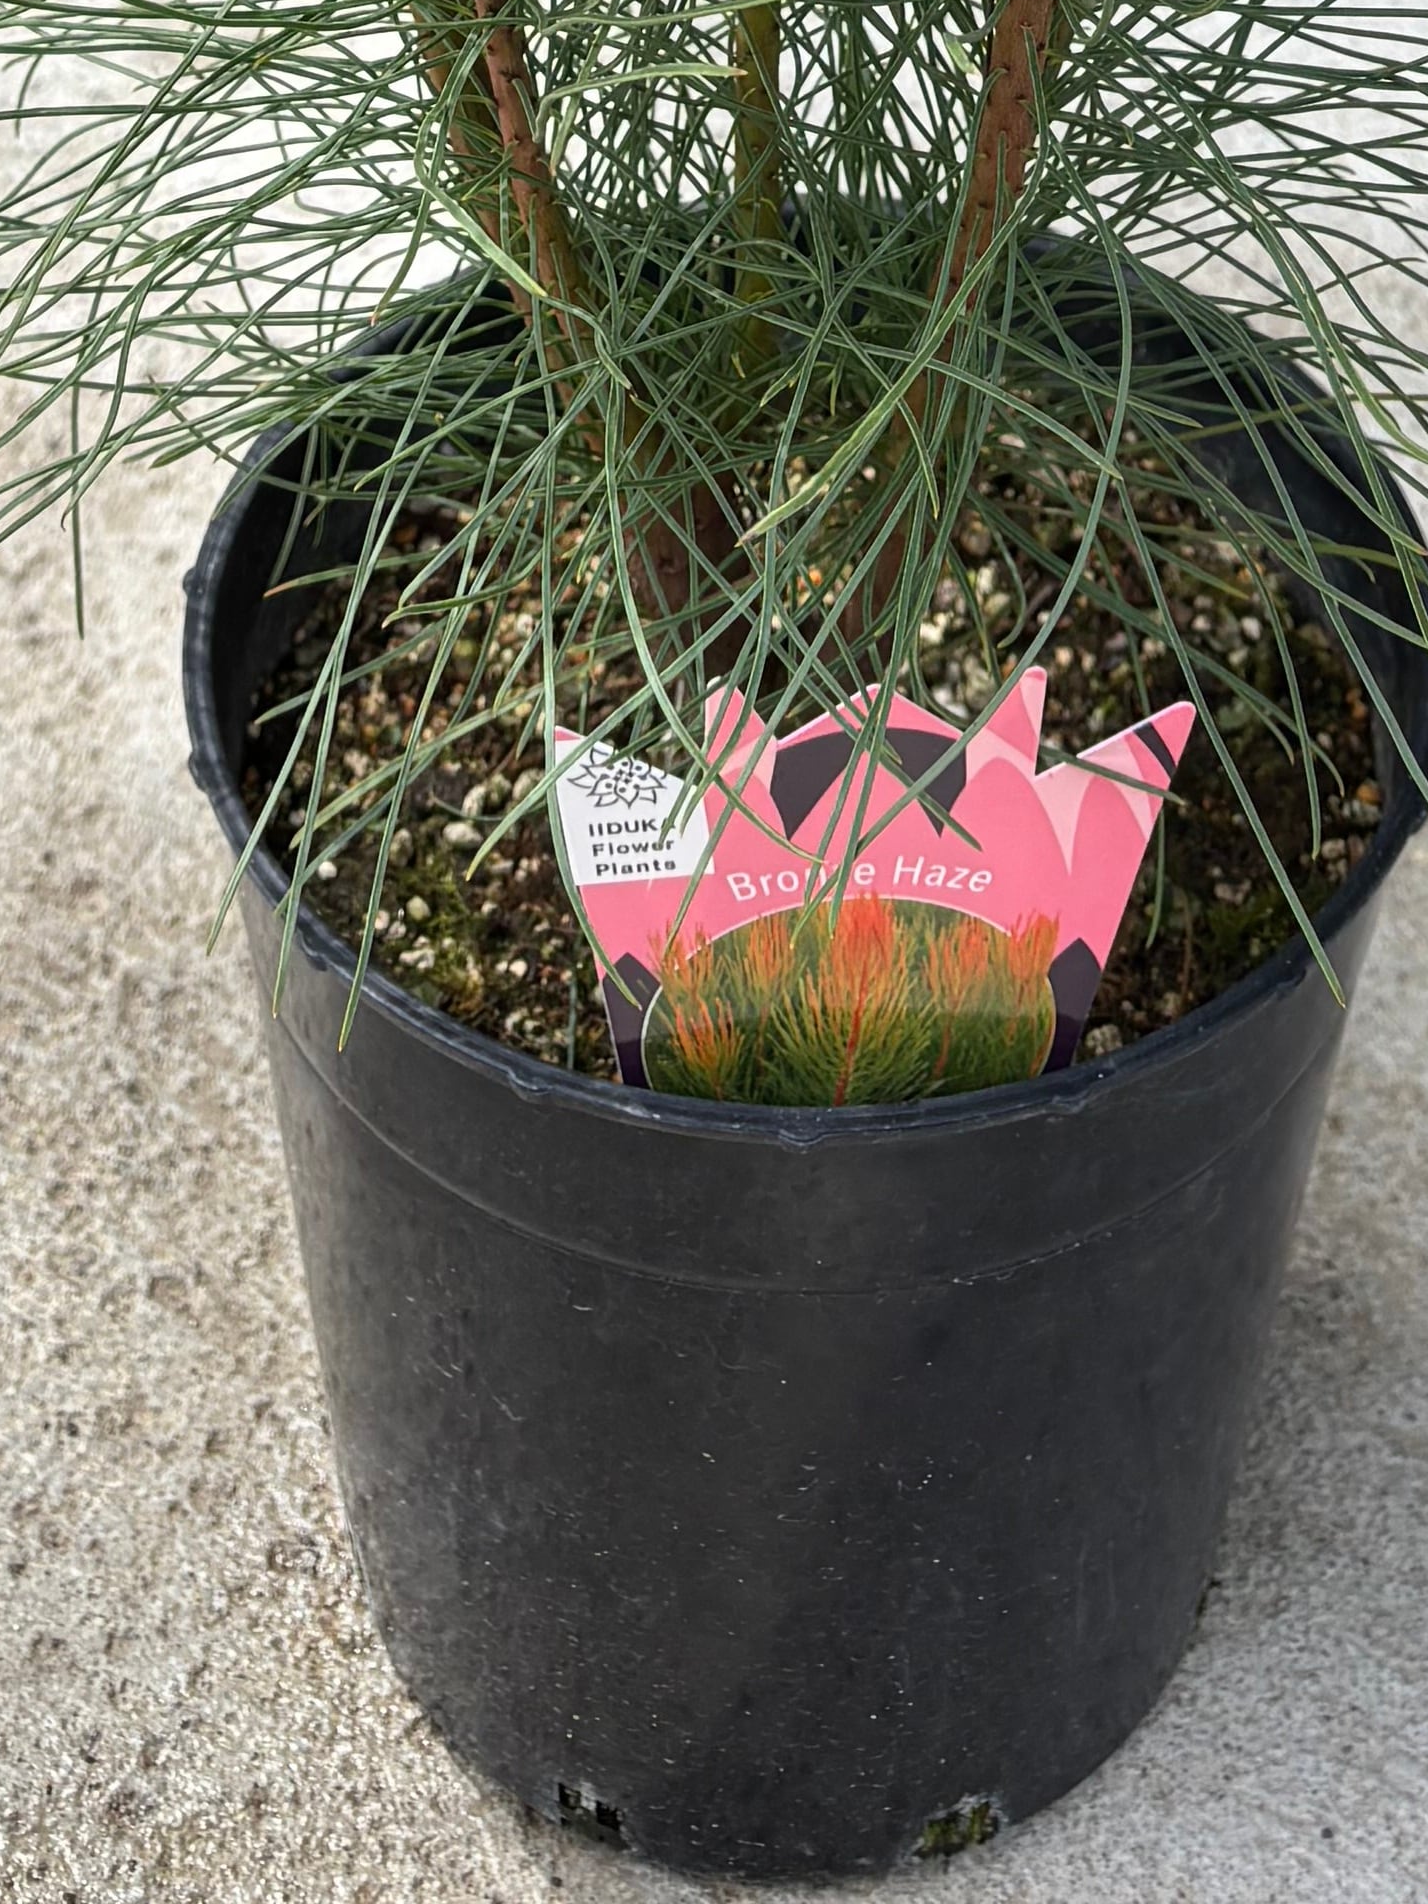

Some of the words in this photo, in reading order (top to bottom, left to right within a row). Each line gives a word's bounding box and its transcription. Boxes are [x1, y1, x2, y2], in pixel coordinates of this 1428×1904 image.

[592, 839, 675, 857] Flower
[595, 859, 676, 877] Plants
[891, 854, 993, 894] Haze
